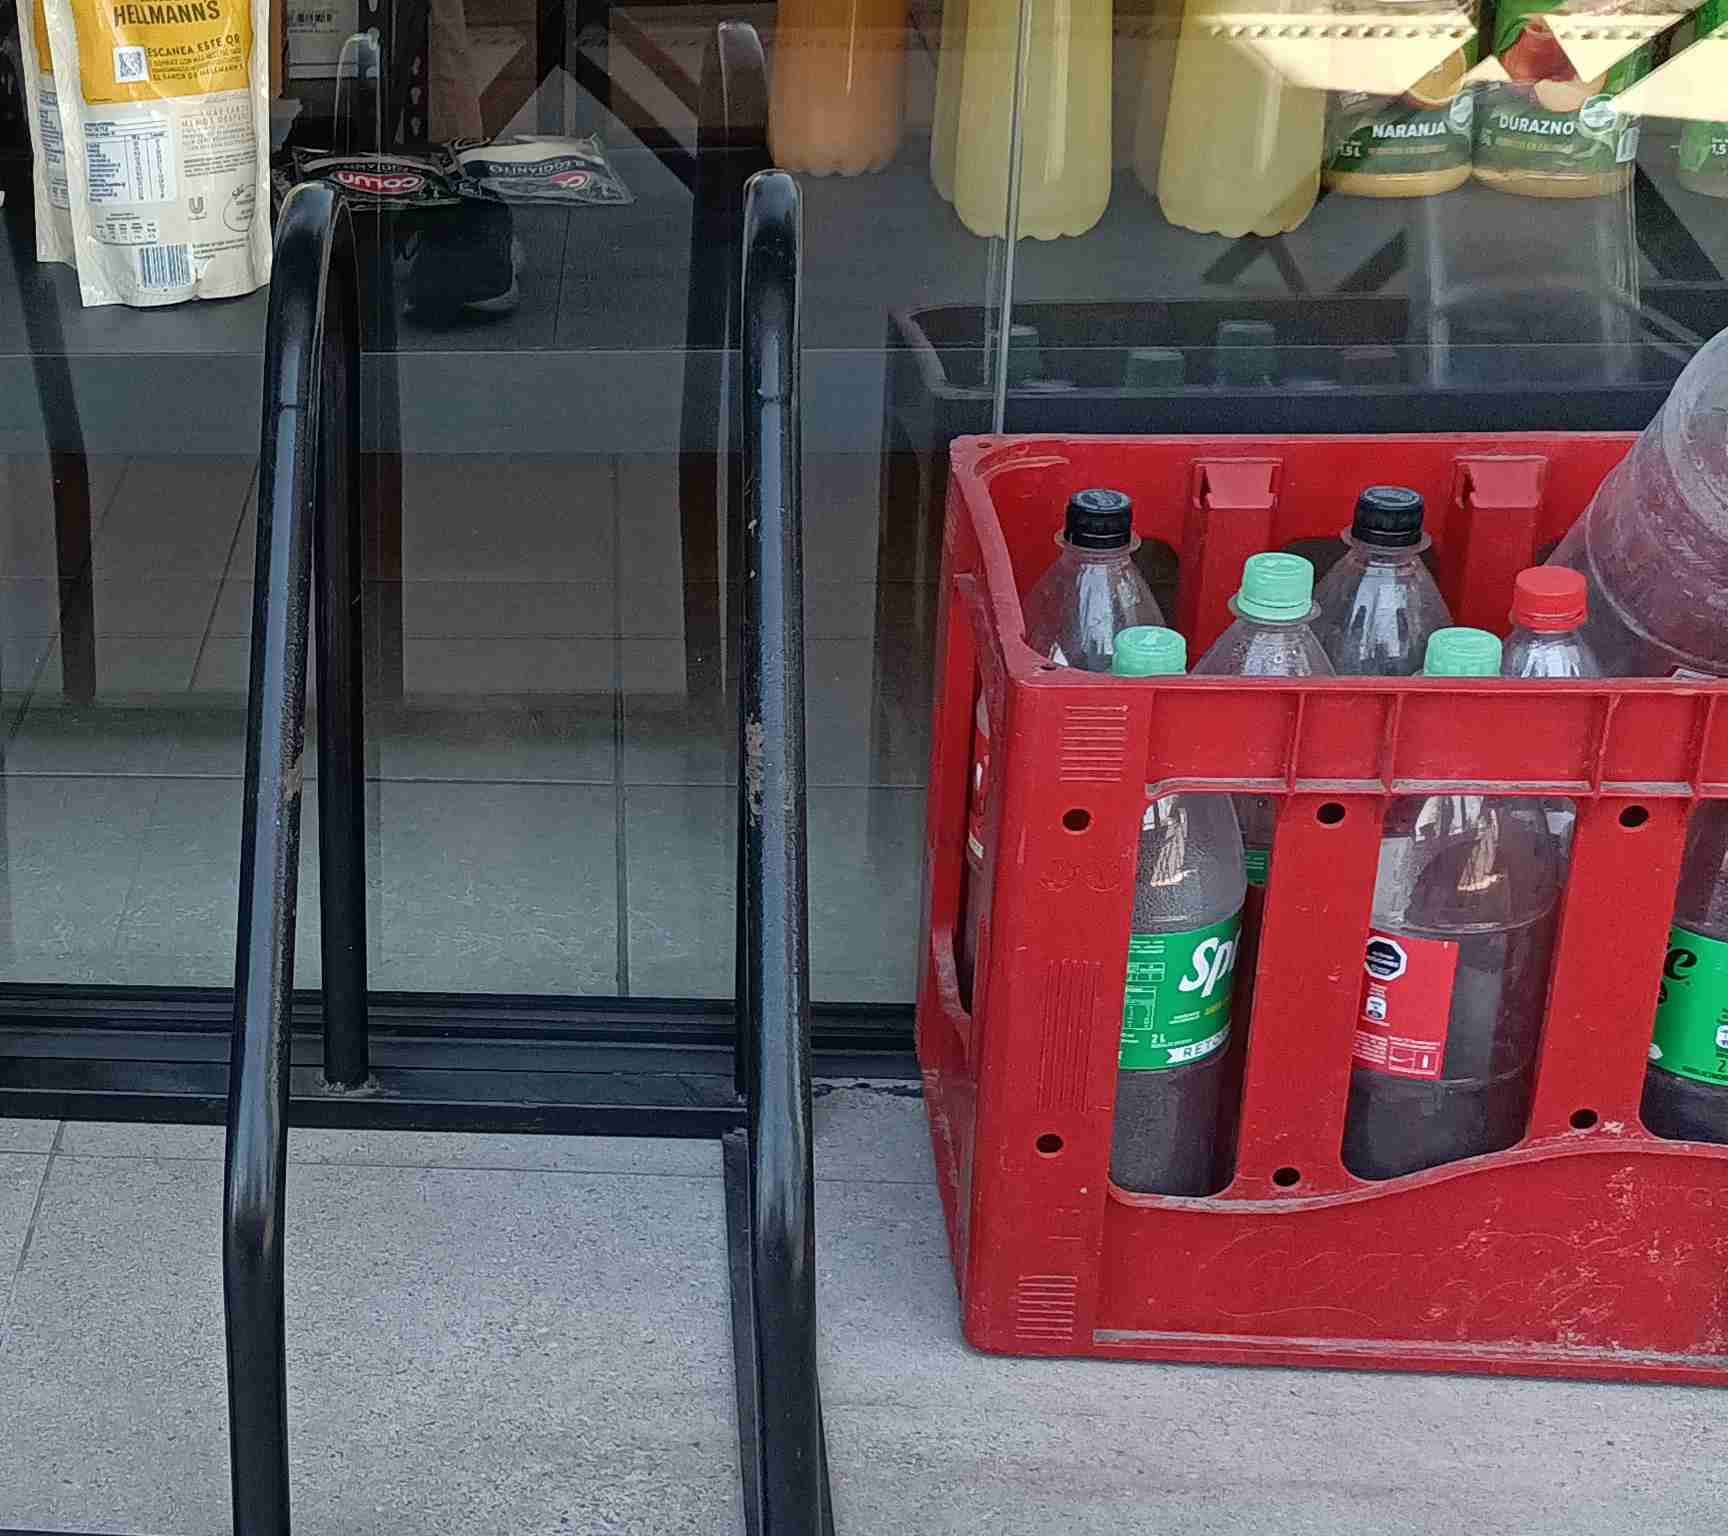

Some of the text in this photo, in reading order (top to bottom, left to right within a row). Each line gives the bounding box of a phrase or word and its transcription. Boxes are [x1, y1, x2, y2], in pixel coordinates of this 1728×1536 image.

[147, 45, 194, 58] ESCANEA
[198, 37, 224, 53] ESTE
[1372, 119, 1447, 140] NARANJA
[1498, 114, 1575, 136] DURAZNO
